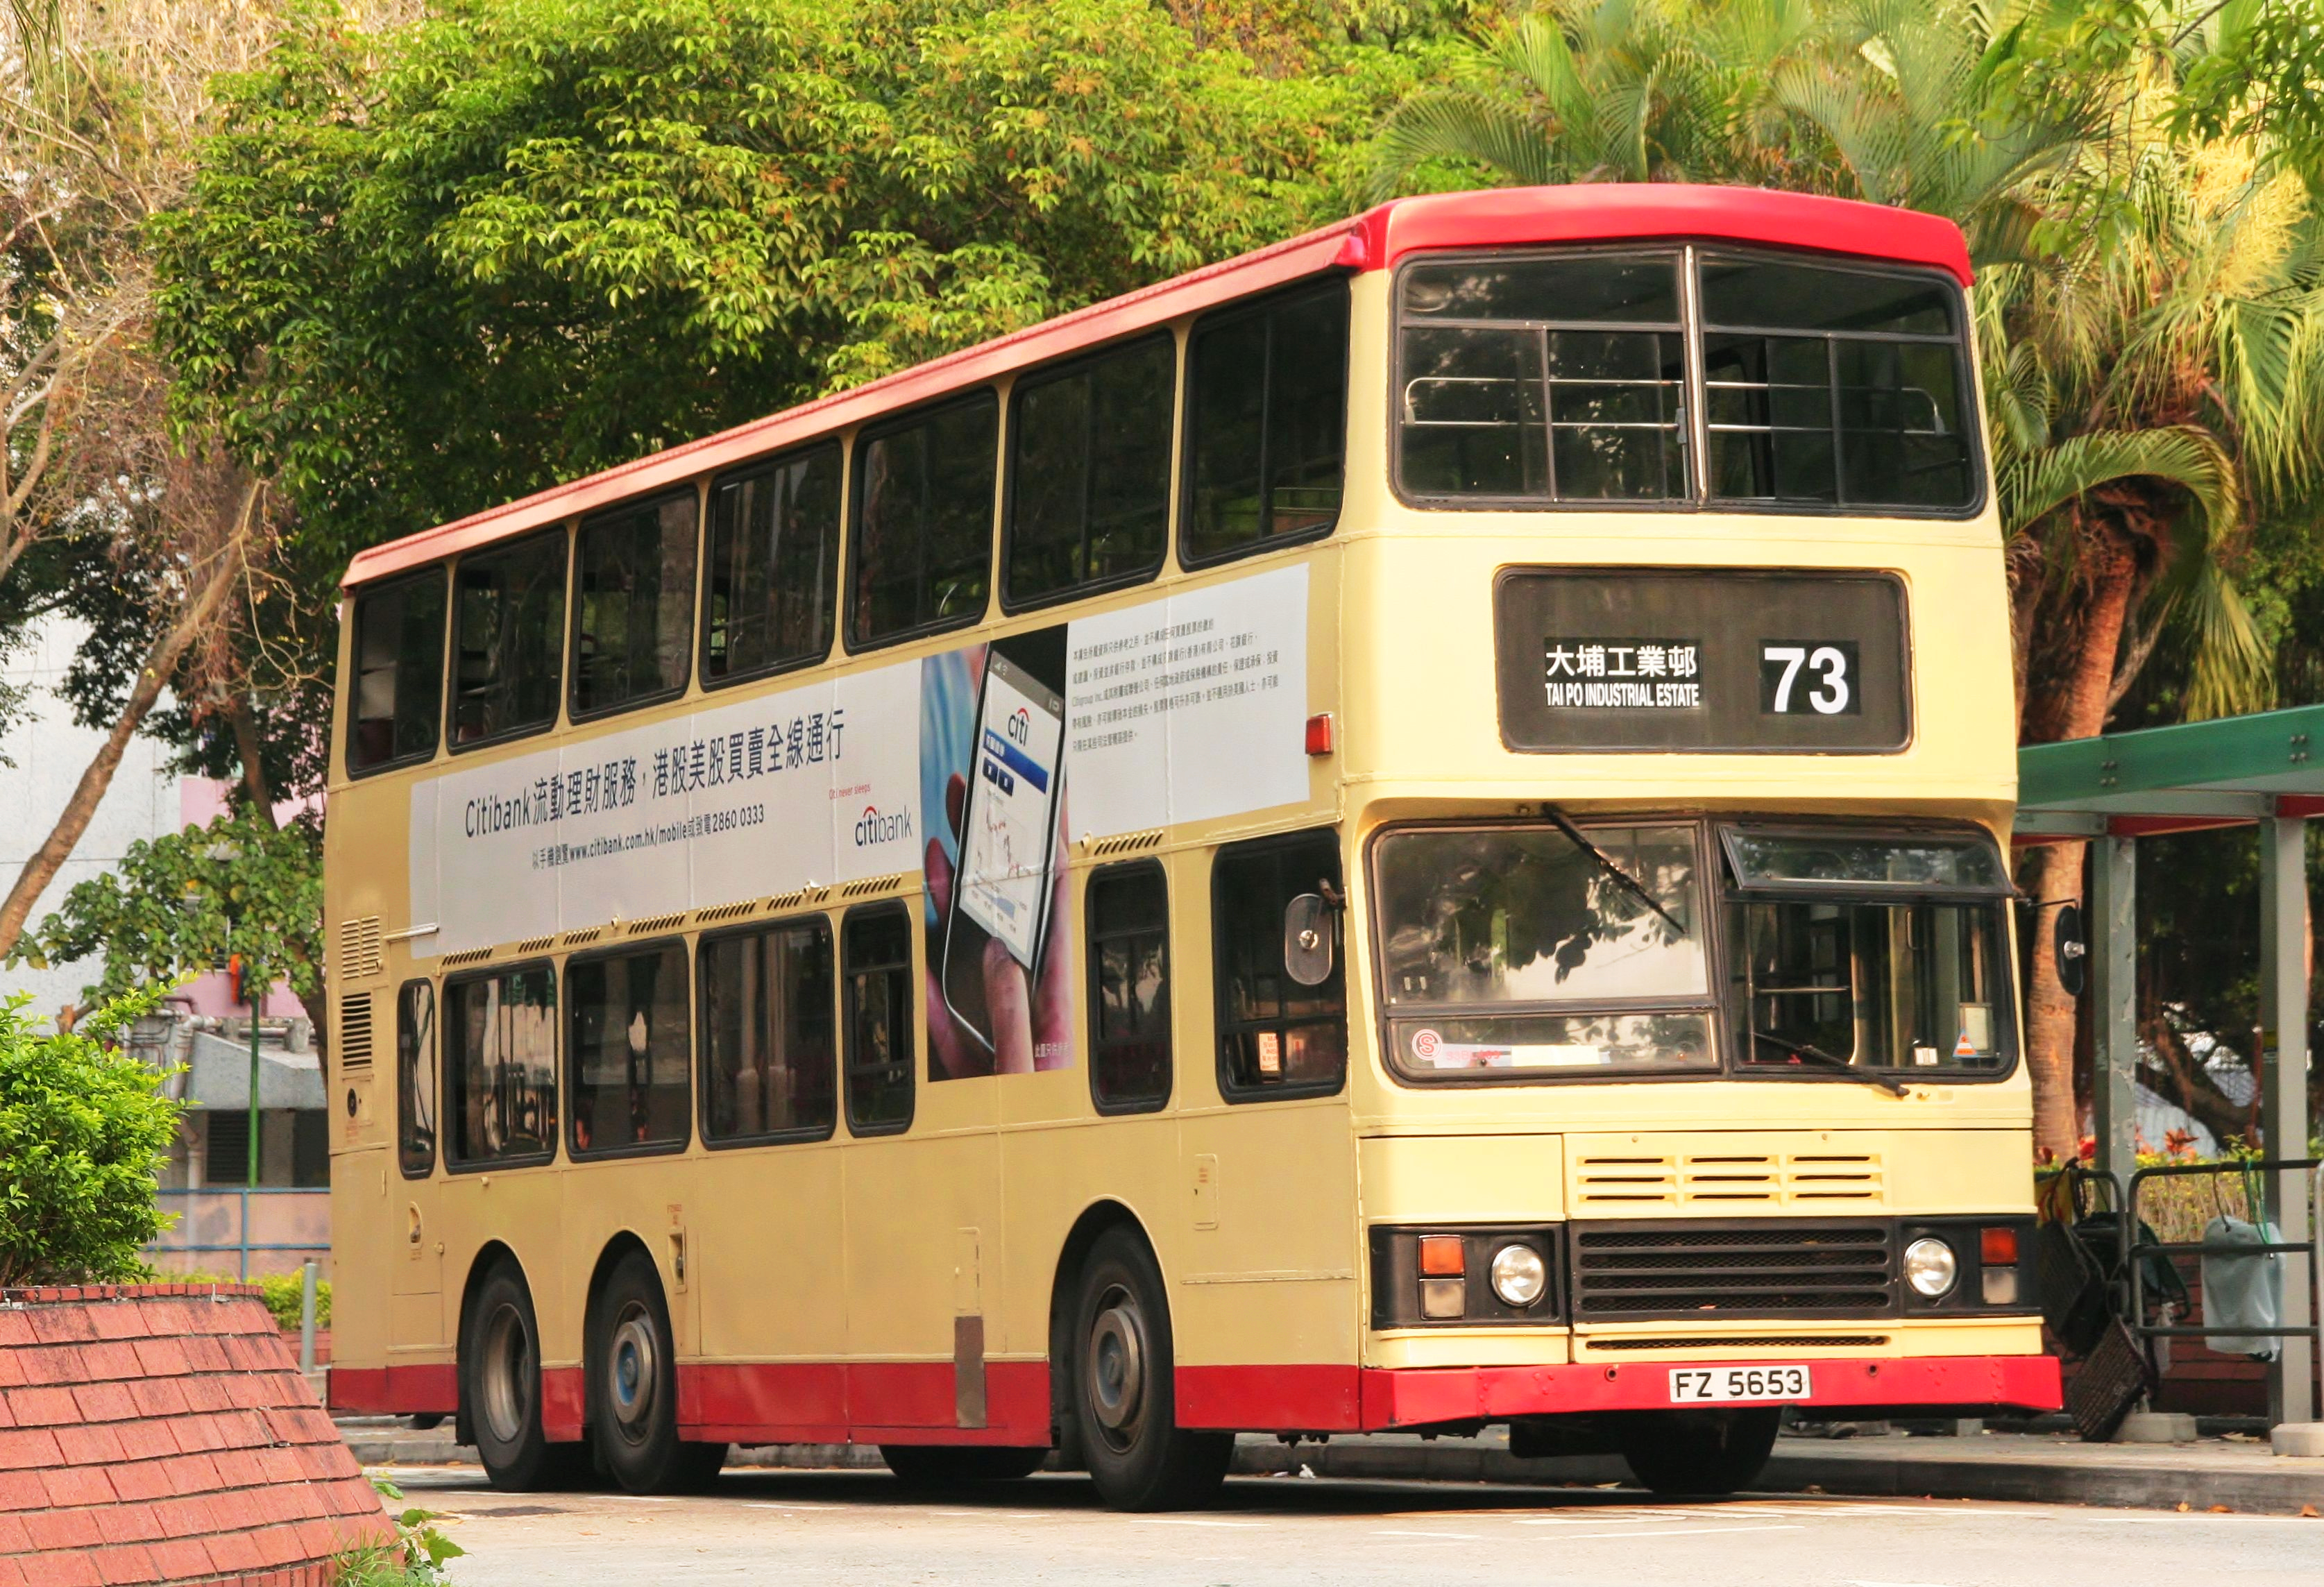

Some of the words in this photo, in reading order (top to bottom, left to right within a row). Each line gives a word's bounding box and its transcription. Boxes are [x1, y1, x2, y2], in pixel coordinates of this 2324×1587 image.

[1545, 645, 1697, 677] 大埔工業邨
[1545, 682, 1563, 706] TAI
[1566, 682, 1583, 706] PO
[1585, 682, 1654, 706] INDUSTRIAL
[1656, 683, 1699, 706] ESTATE
[1765, 647, 1849, 714] 73
[1008, 708, 1029, 747] citi
[740, 803, 764, 827] 0333
[855, 805, 912, 847] citibank
[1419, 1034, 1435, 1054] S
[1675, 1372, 1713, 1398] FZ
[1728, 1369, 1804, 1397] 5653
